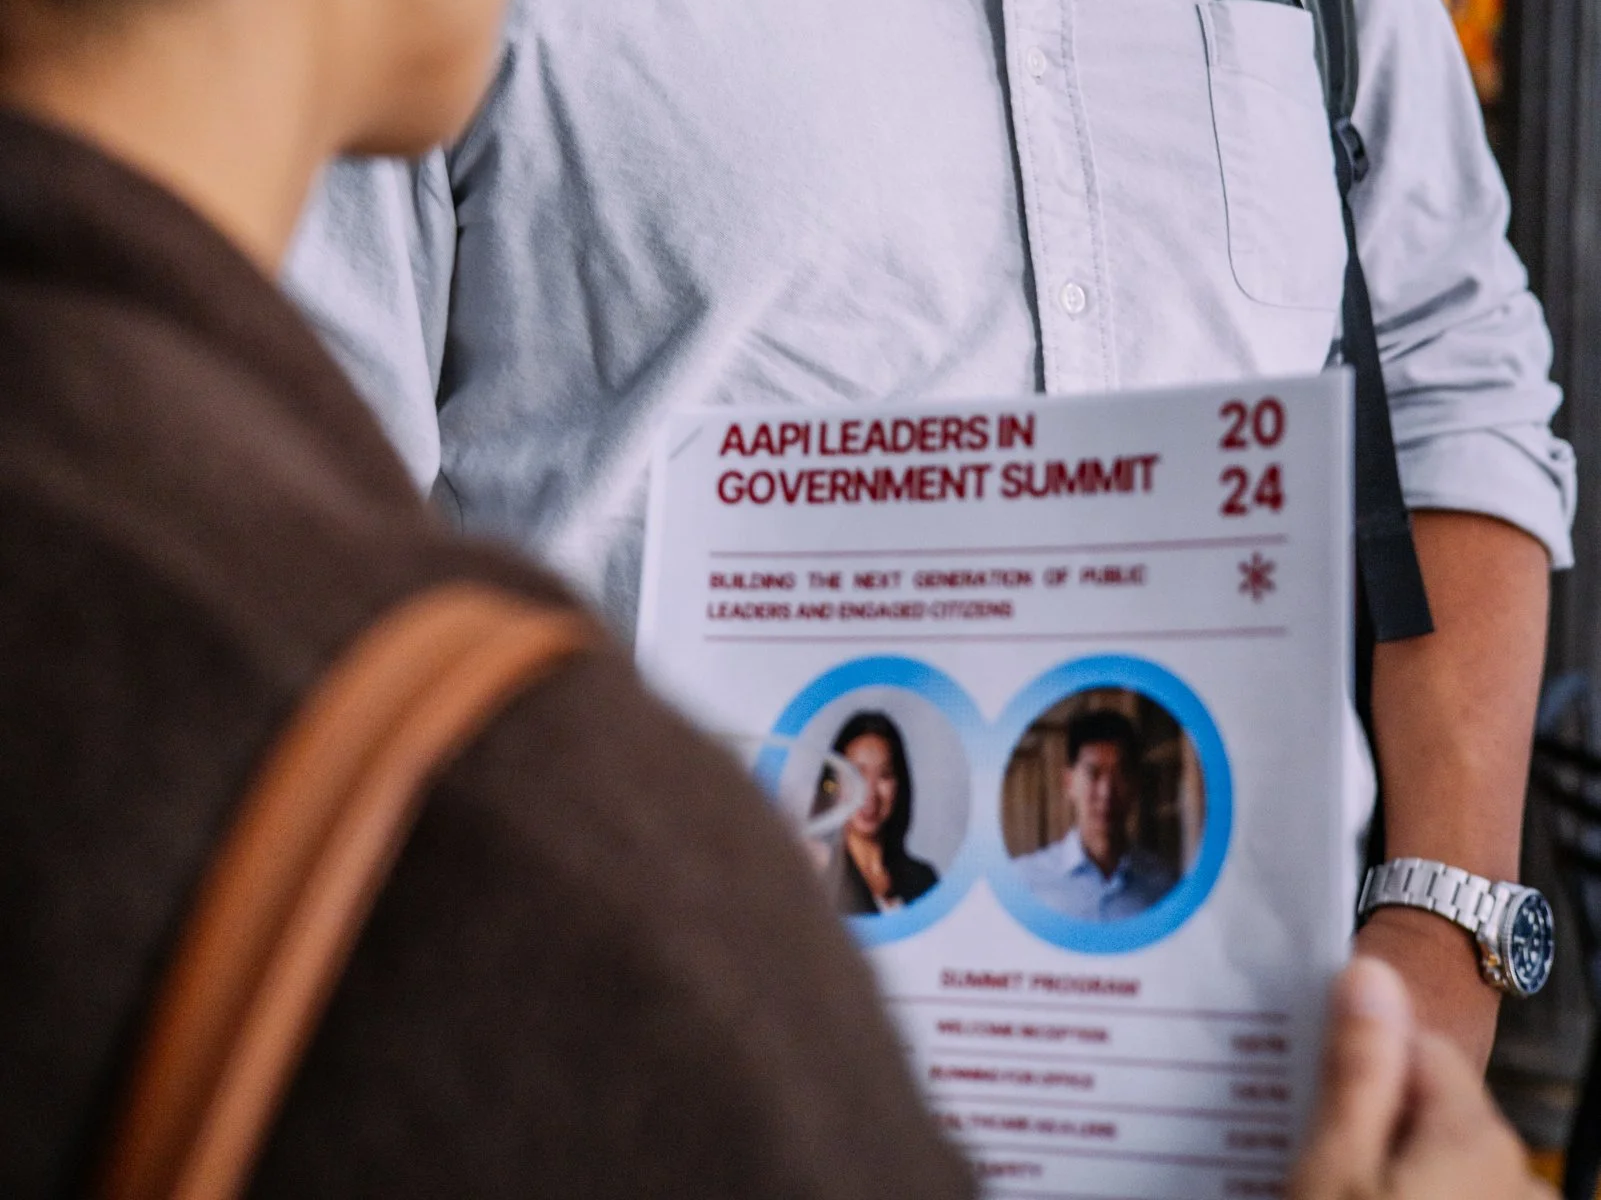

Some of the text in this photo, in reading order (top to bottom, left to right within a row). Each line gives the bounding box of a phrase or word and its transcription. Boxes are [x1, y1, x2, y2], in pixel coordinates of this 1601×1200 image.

[719, 411, 1036, 457] AAPI LEADERS IN
[1218, 395, 1286, 450] 20
[717, 452, 1161, 505] GOVERNMENT SUMMIT
[1218, 463, 1285, 517] 24
[708, 563, 1147, 592] BUILDING THE NEXT GENERATION OF PUBLIC
[706, 599, 1015, 622] LEADERS AND ENGAGED CITIZENS
